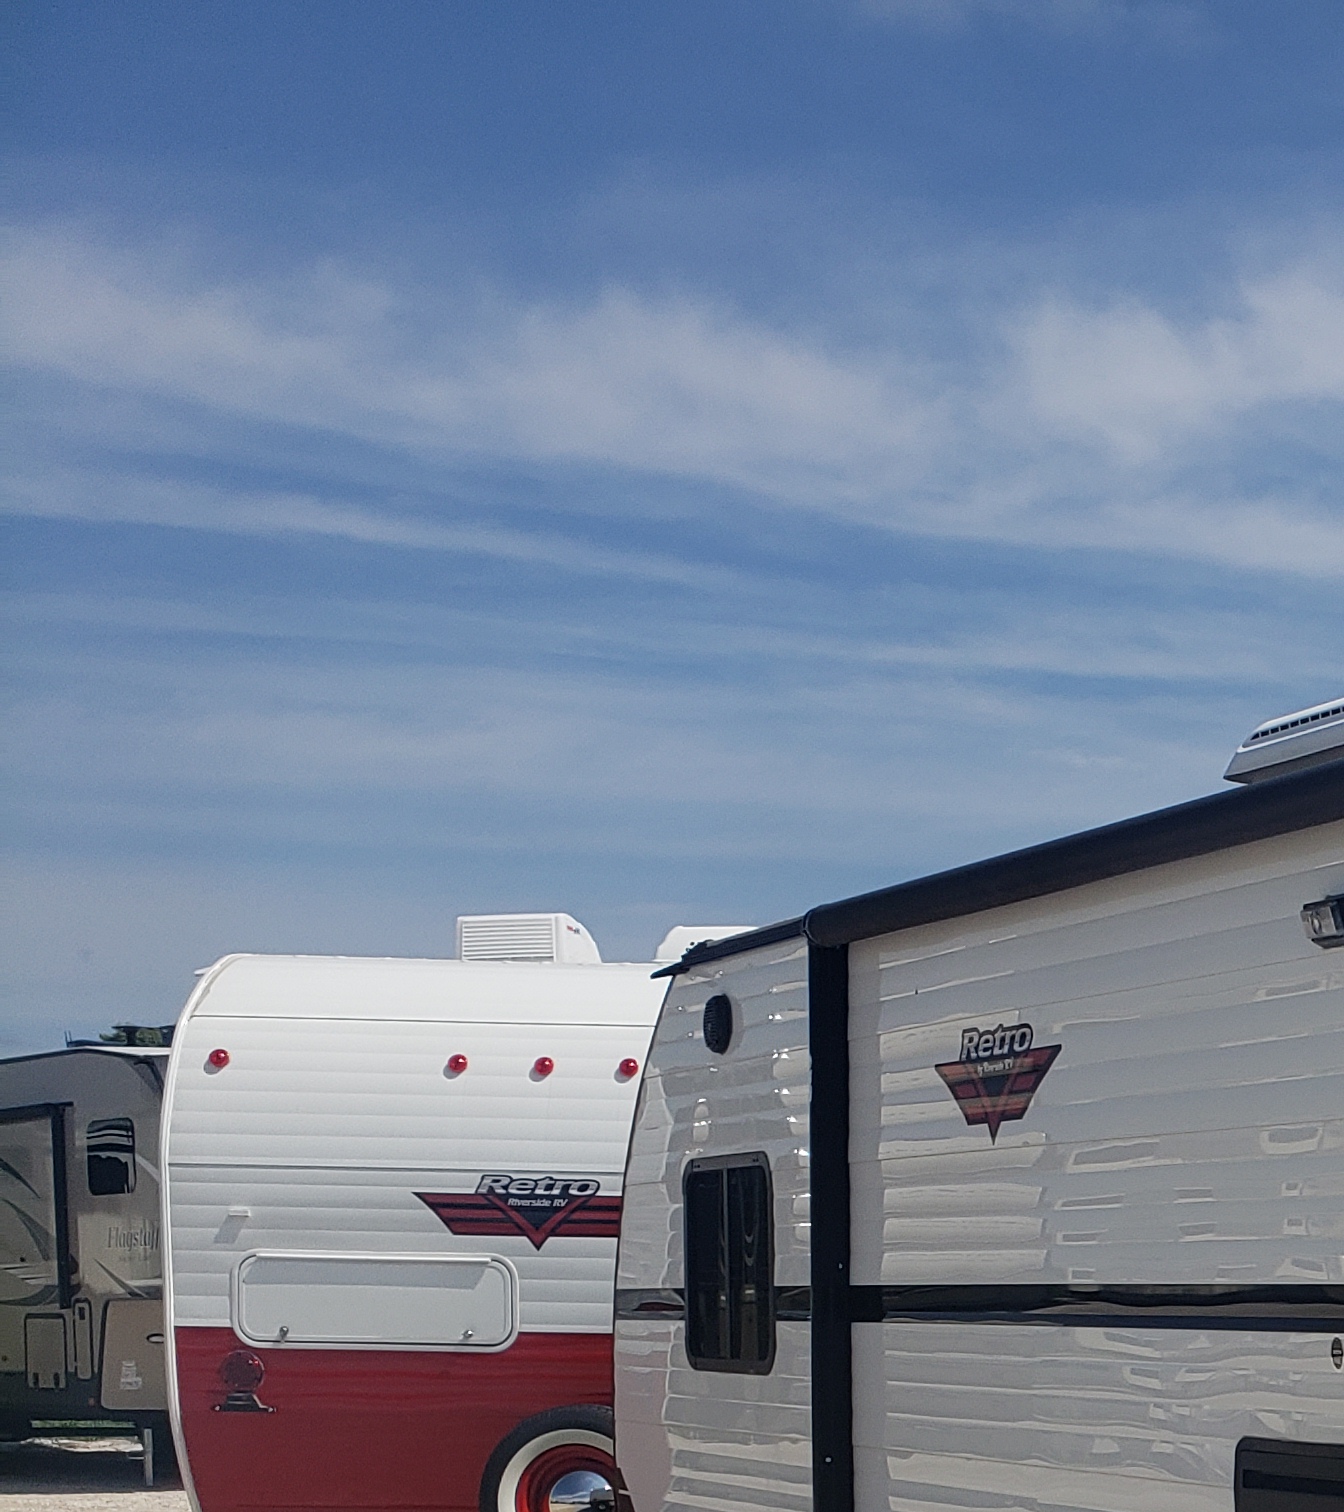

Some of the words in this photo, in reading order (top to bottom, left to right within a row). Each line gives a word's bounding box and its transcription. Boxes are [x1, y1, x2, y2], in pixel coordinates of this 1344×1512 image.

[960, 1025, 1032, 1060] Retro
[476, 1174, 600, 1196] Retro
[507, 1197, 552, 1207] Riverside
[552, 1198, 569, 1208] RV
[107, 1226, 160, 1251] Flagstaff
